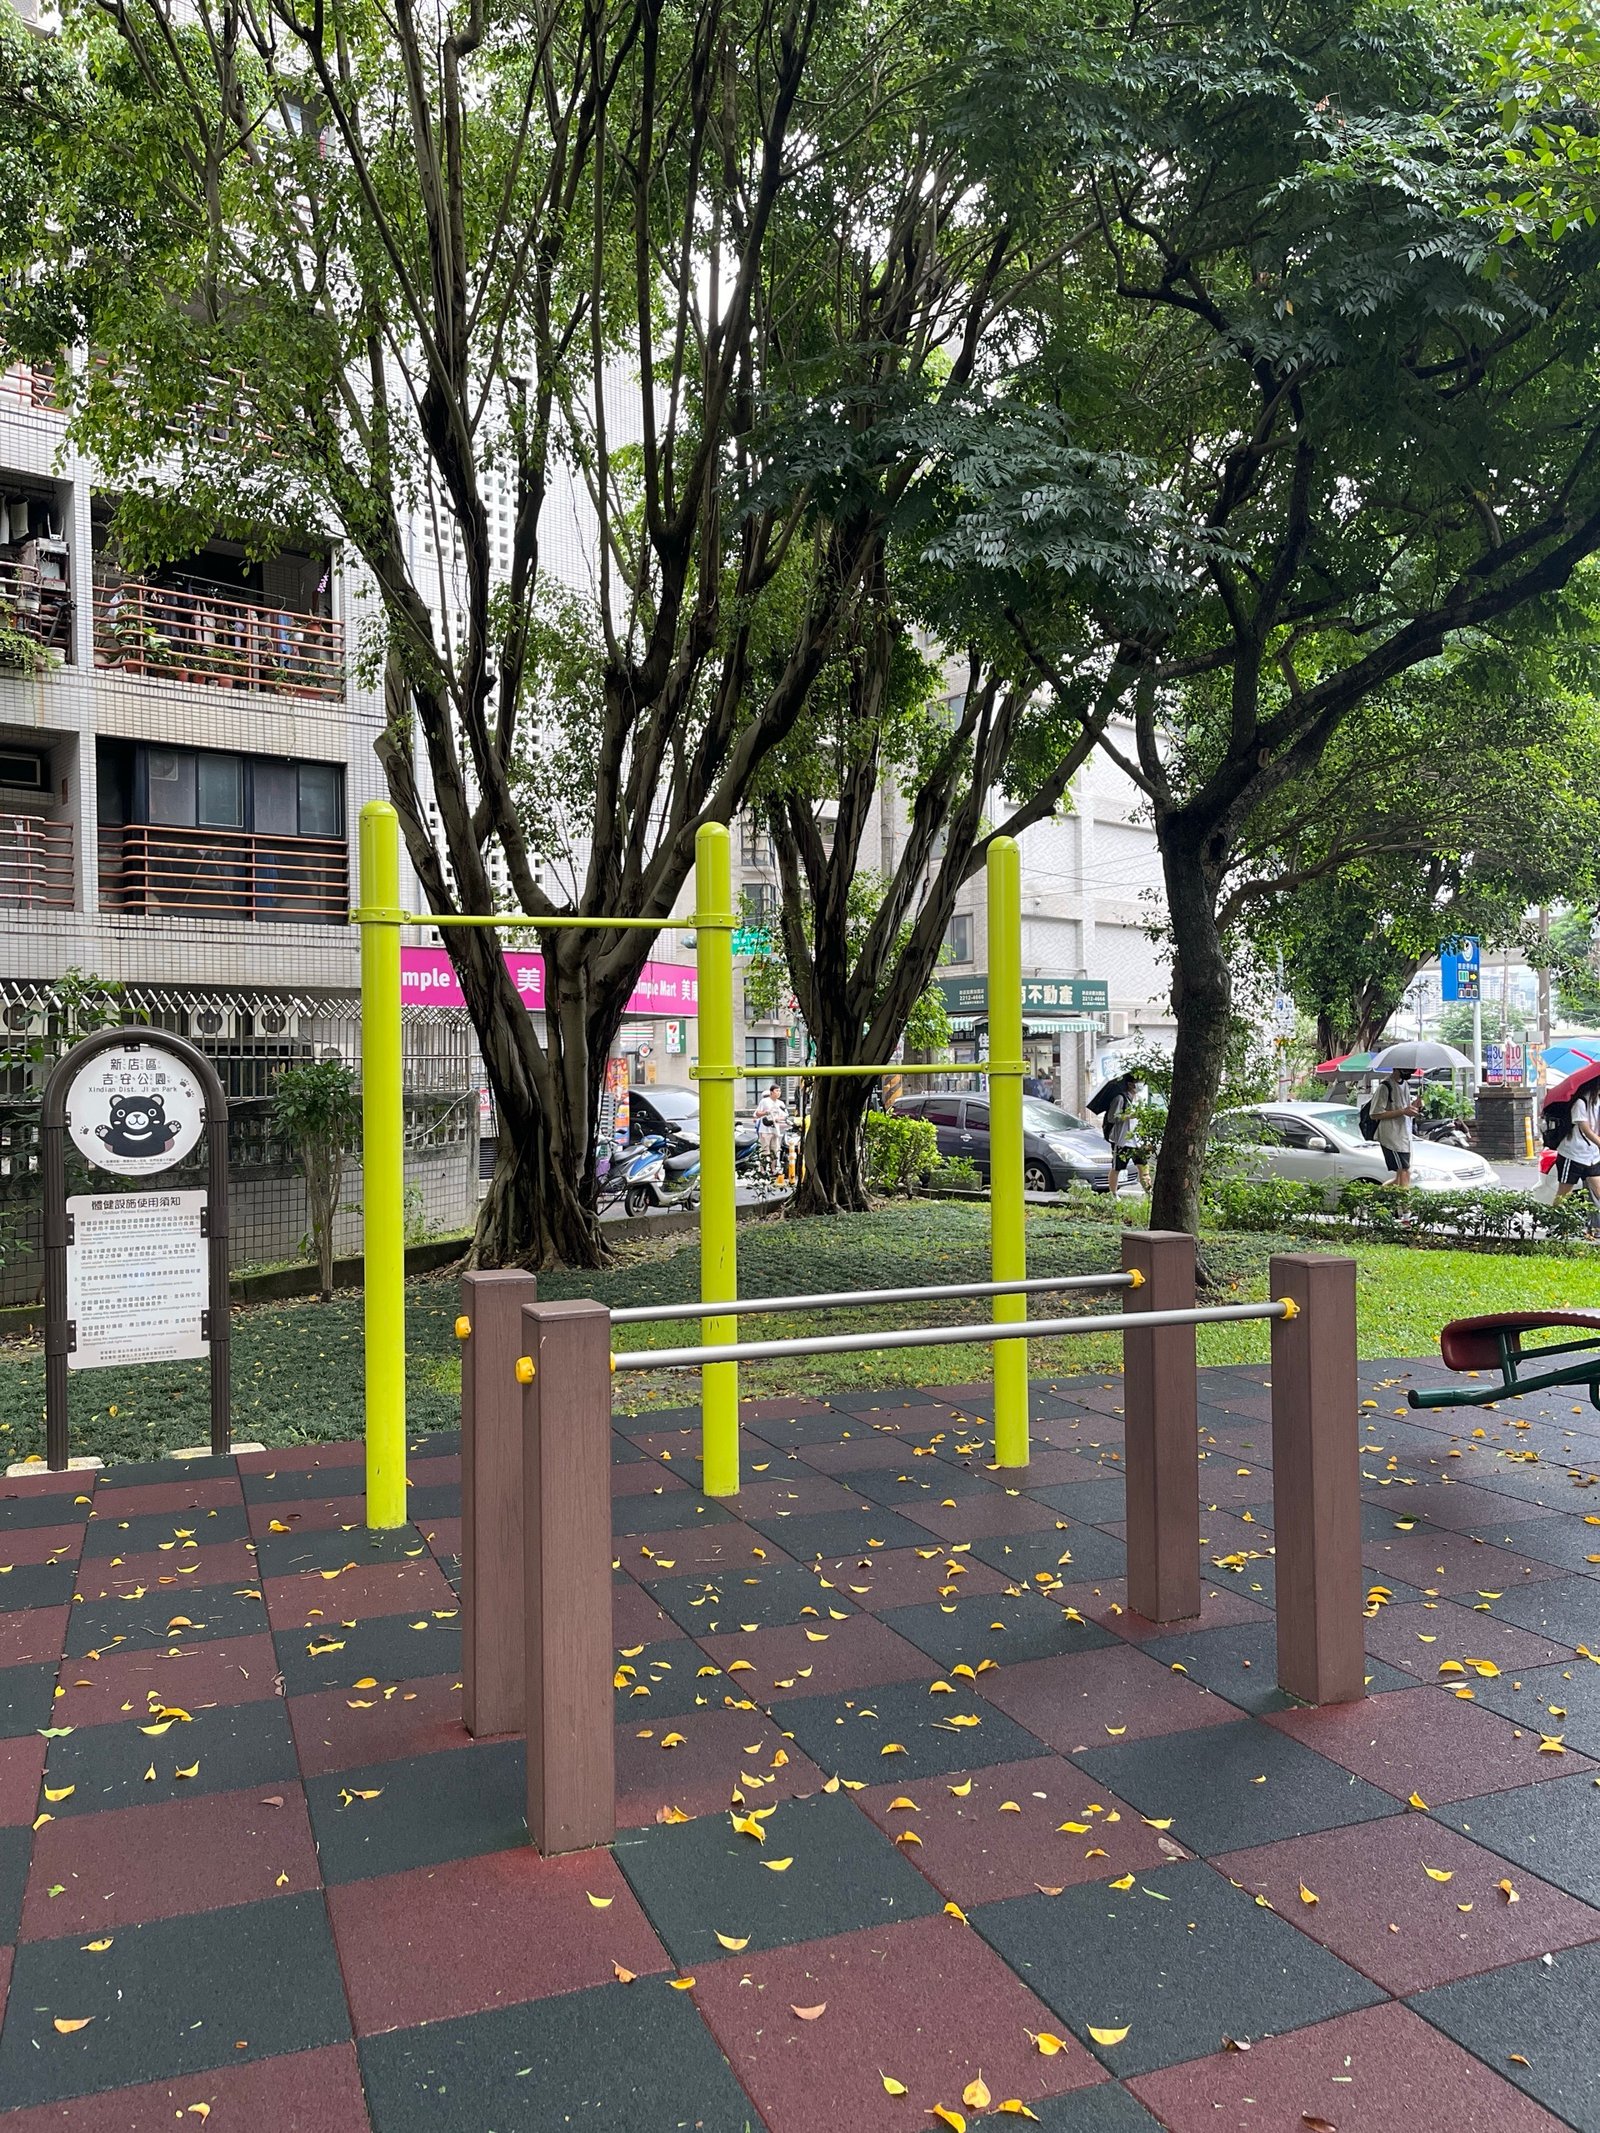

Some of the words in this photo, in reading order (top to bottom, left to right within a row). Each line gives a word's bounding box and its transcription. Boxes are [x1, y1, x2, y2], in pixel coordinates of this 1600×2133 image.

[402, 968, 450, 992] mple
[660, 980, 677, 997] Mart
[110, 1058, 157, 1070] 新店區
[102, 1073, 166, 1085] 吉安公園
